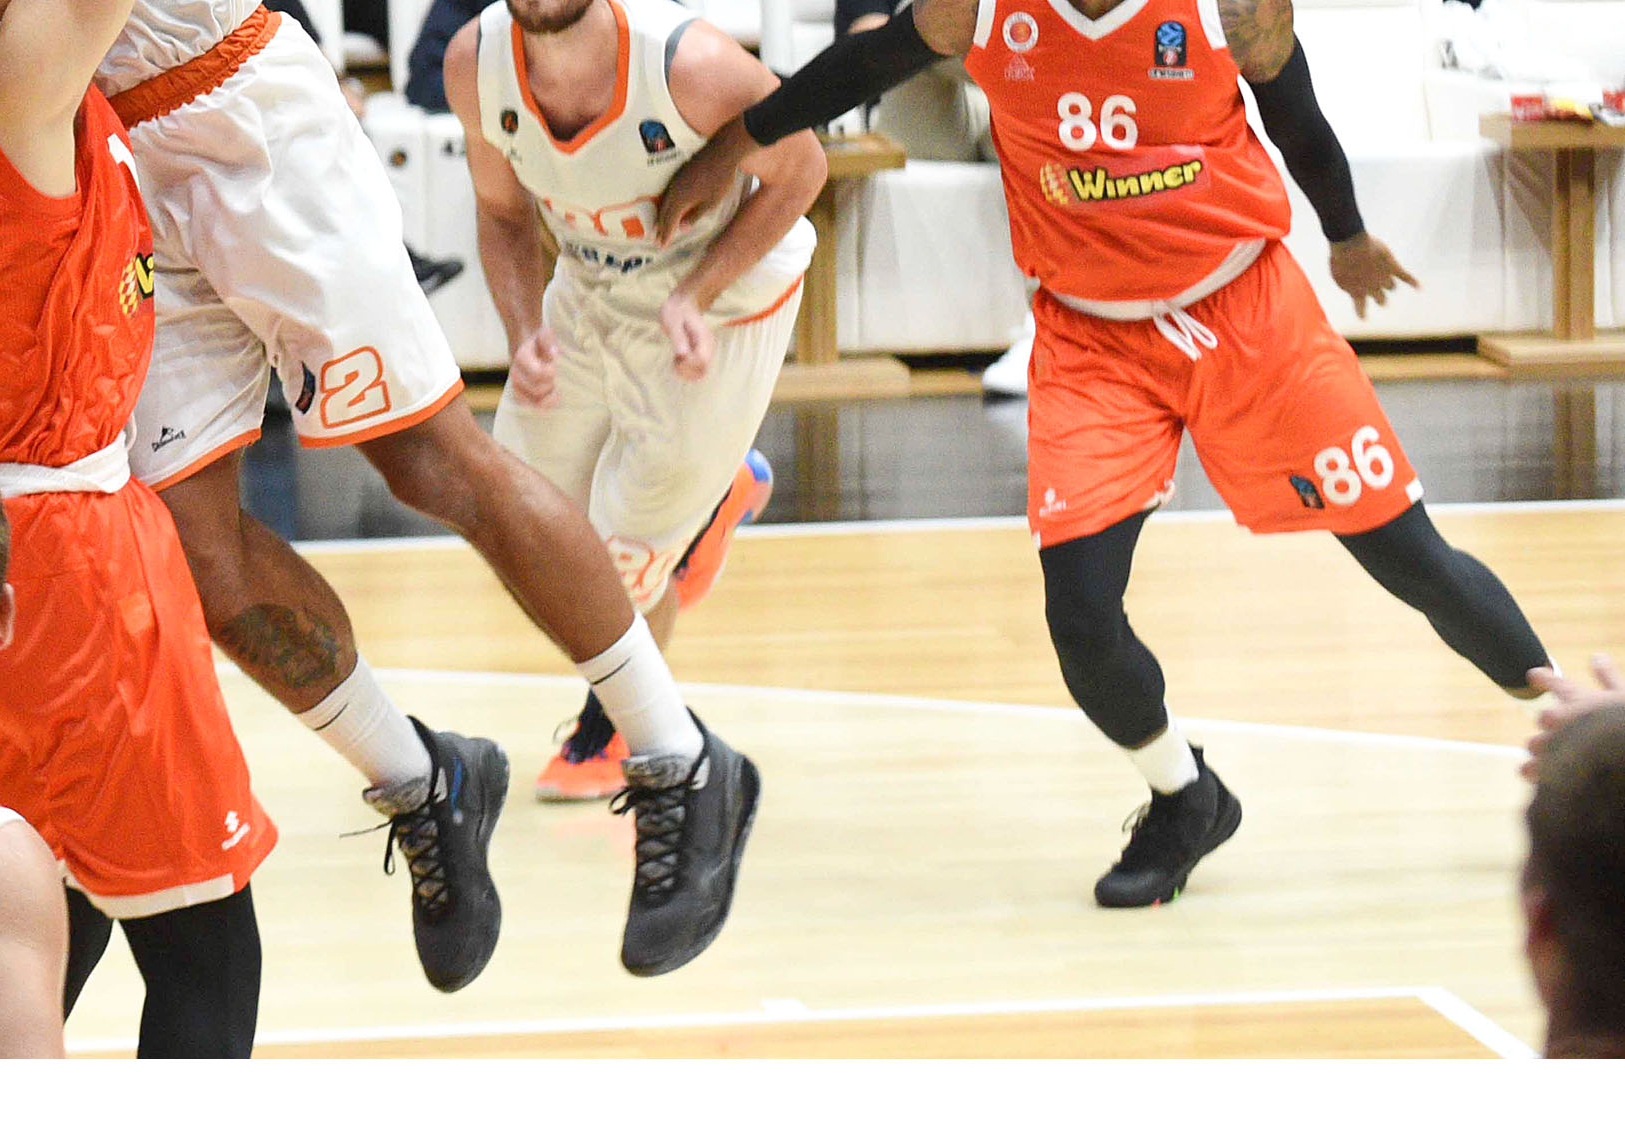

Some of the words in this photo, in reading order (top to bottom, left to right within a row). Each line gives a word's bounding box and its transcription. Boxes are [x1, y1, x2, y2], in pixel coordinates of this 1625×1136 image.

[1057, 91, 1139, 152] 86
[1067, 159, 1204, 202] Winner
[320, 345, 392, 430] 2
[1313, 425, 1395, 507] 86
